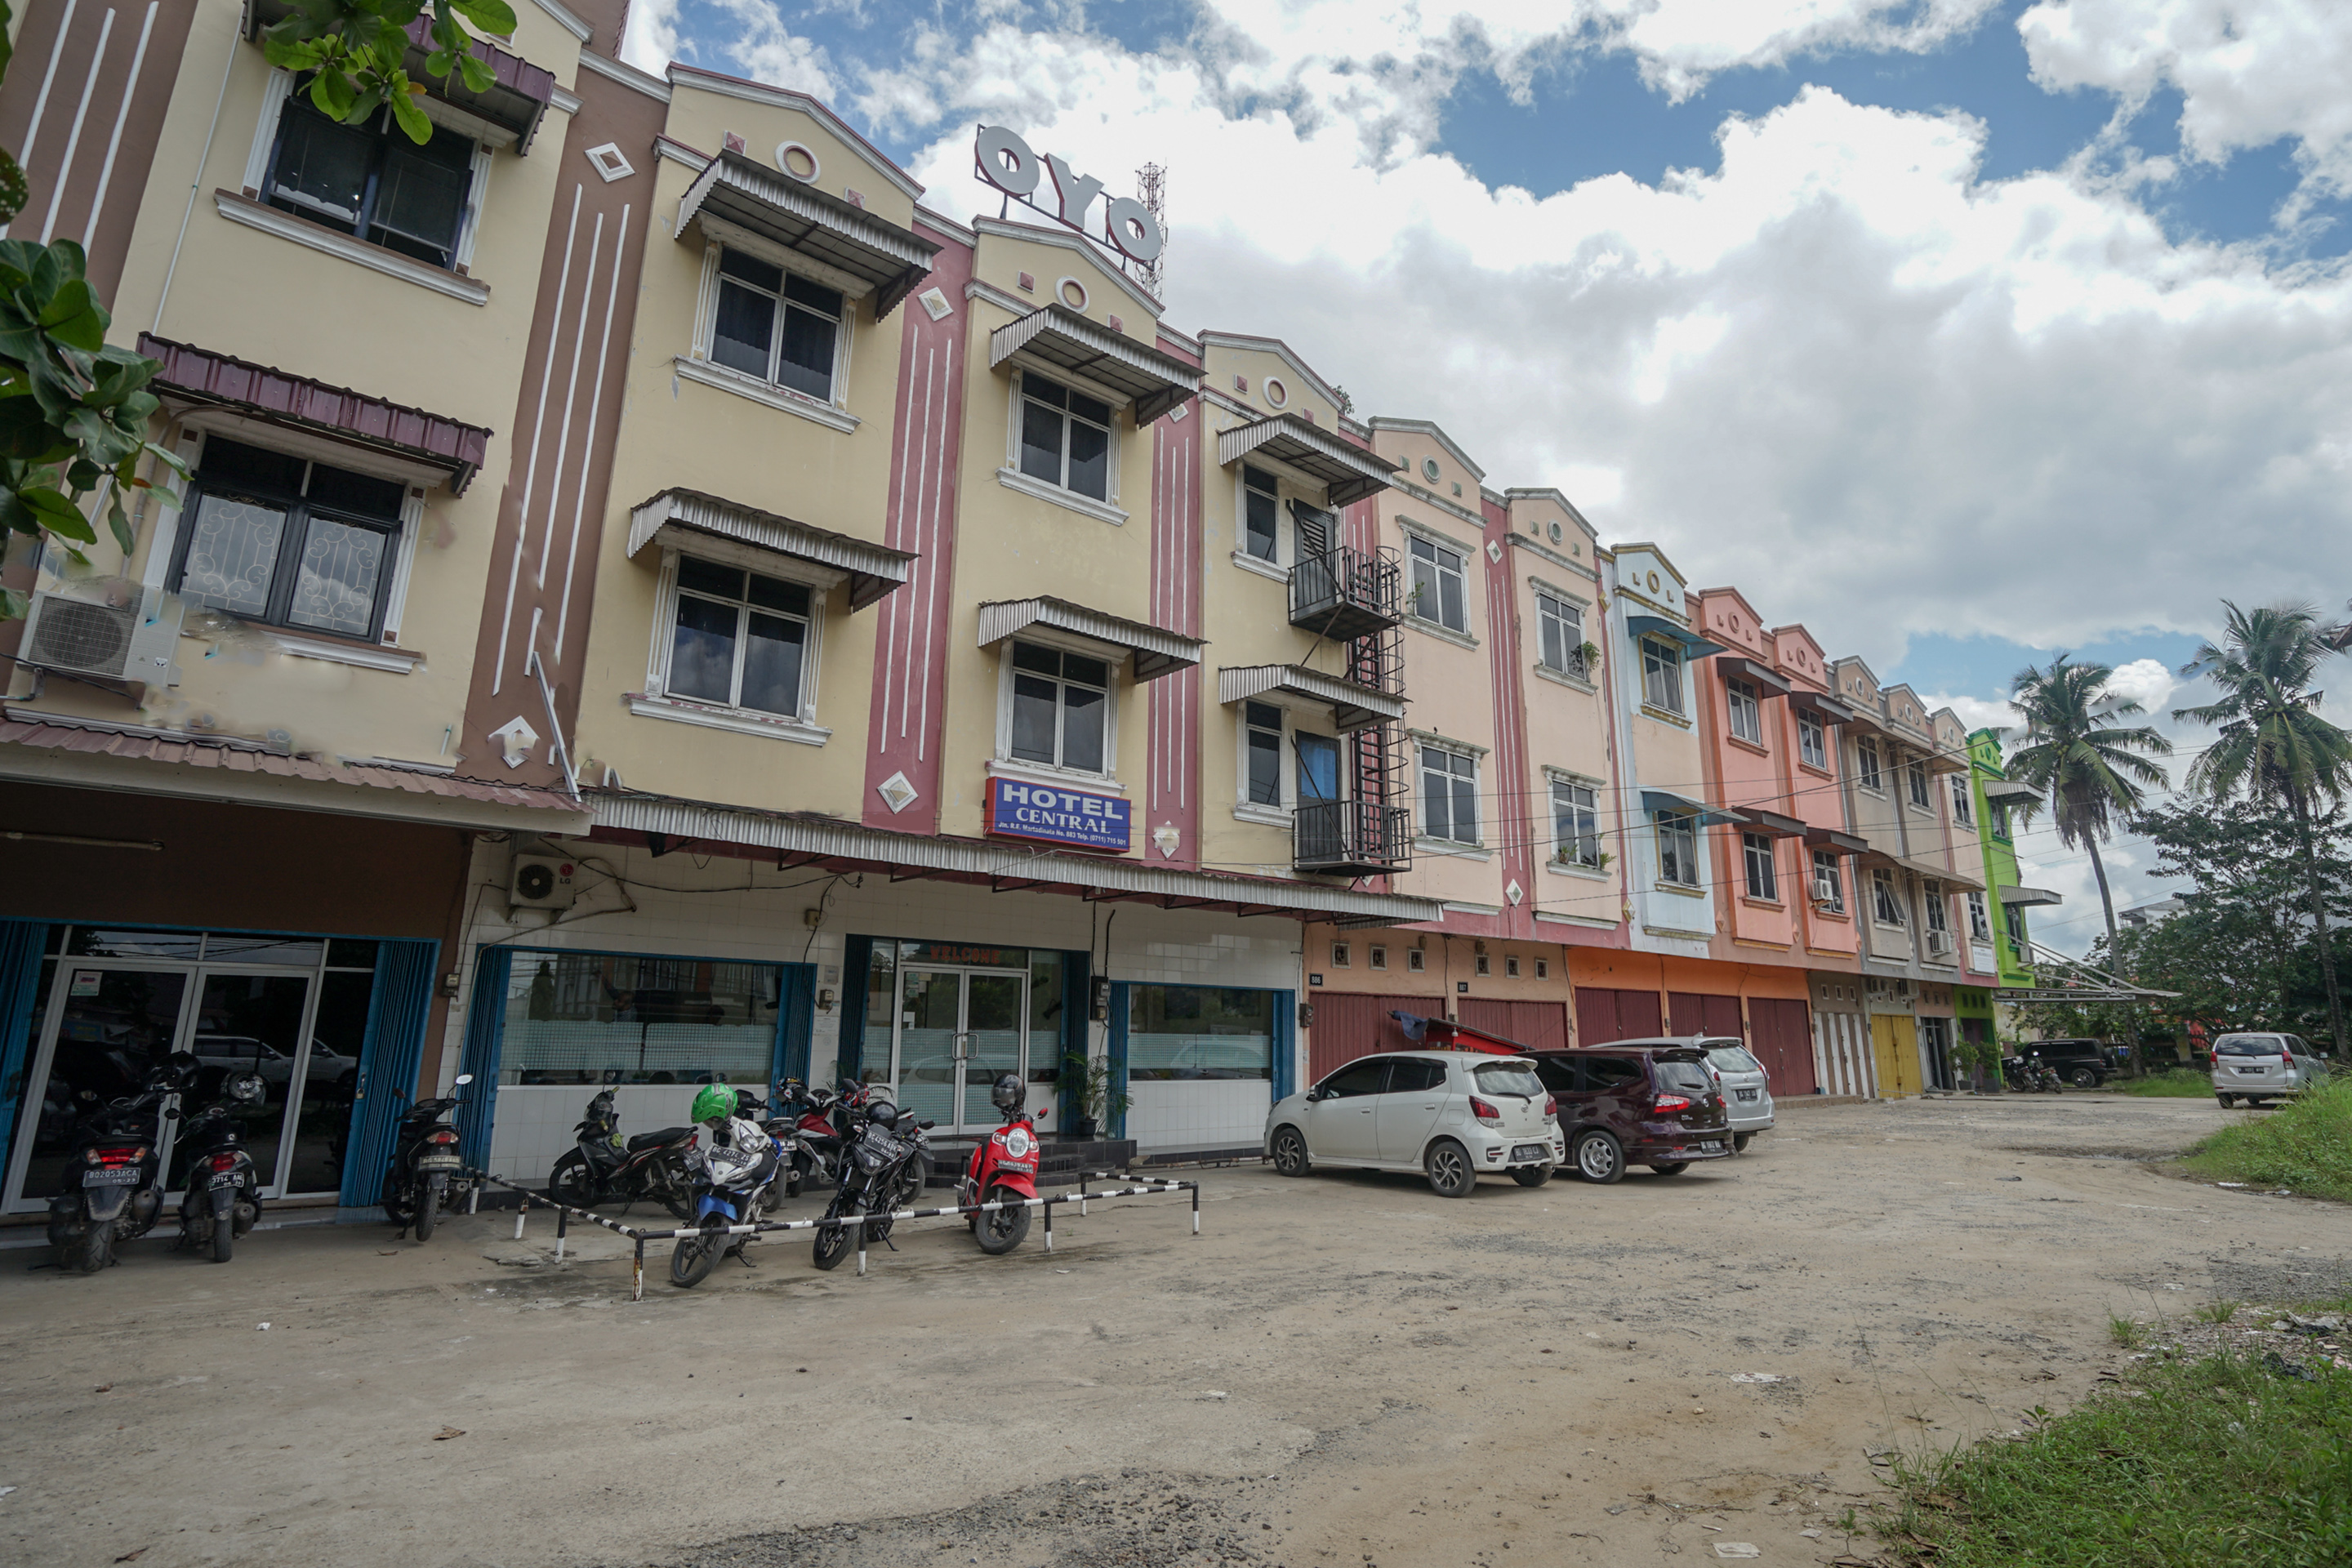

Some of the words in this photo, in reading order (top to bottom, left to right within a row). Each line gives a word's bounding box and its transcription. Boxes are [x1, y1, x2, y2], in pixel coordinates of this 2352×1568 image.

[975, 126, 1162, 263] OYO
[1003, 784, 1123, 820] HOTEL
[1016, 807, 1111, 834] CENTRAL
[1022, 824, 1055, 835] Martadinata
[1077, 832, 1089, 840] Telp.
[1090, 834, 1107, 844] (0711)
[930, 945, 1000, 964] WELCOME
